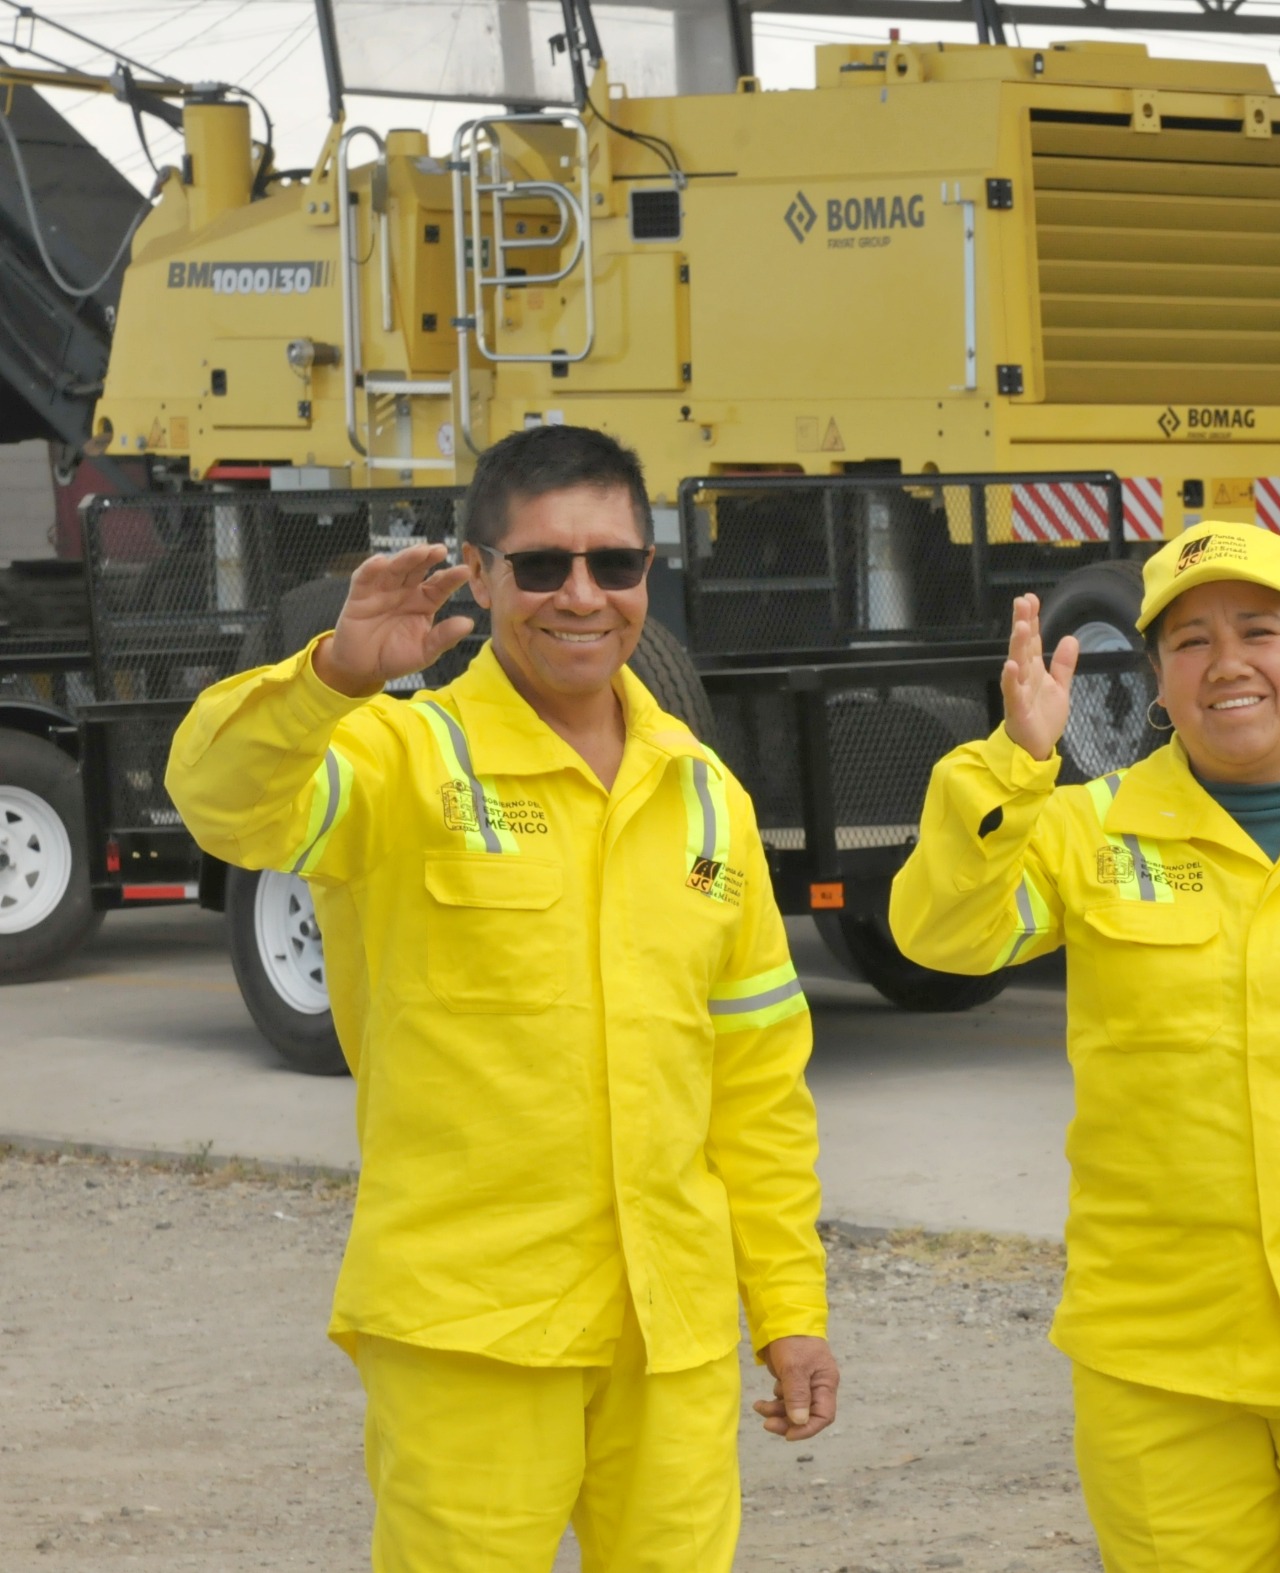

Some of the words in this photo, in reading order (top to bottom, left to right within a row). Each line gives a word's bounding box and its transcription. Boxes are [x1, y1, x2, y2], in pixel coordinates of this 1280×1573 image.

[827, 194, 925, 232] BOMAG
[858, 236, 891, 248] GROUP
[1188, 408, 1255, 428] BOMAG
[1178, 553, 1200, 570] JC
[482, 796, 526, 808] GOBIERNO
[528, 800, 542, 809] DEL
[483, 805, 528, 819] ESTADO
[531, 811, 545, 820] DE
[485, 817, 548, 834] MÉXICO
[1141, 858, 1184, 871] GOBIERNO
[1187, 861, 1202, 869] DEL
[1141, 863, 1185, 880] ESTADO
[1189, 872, 1203, 880] DE
[1141, 871, 1204, 892] MÉXICO
